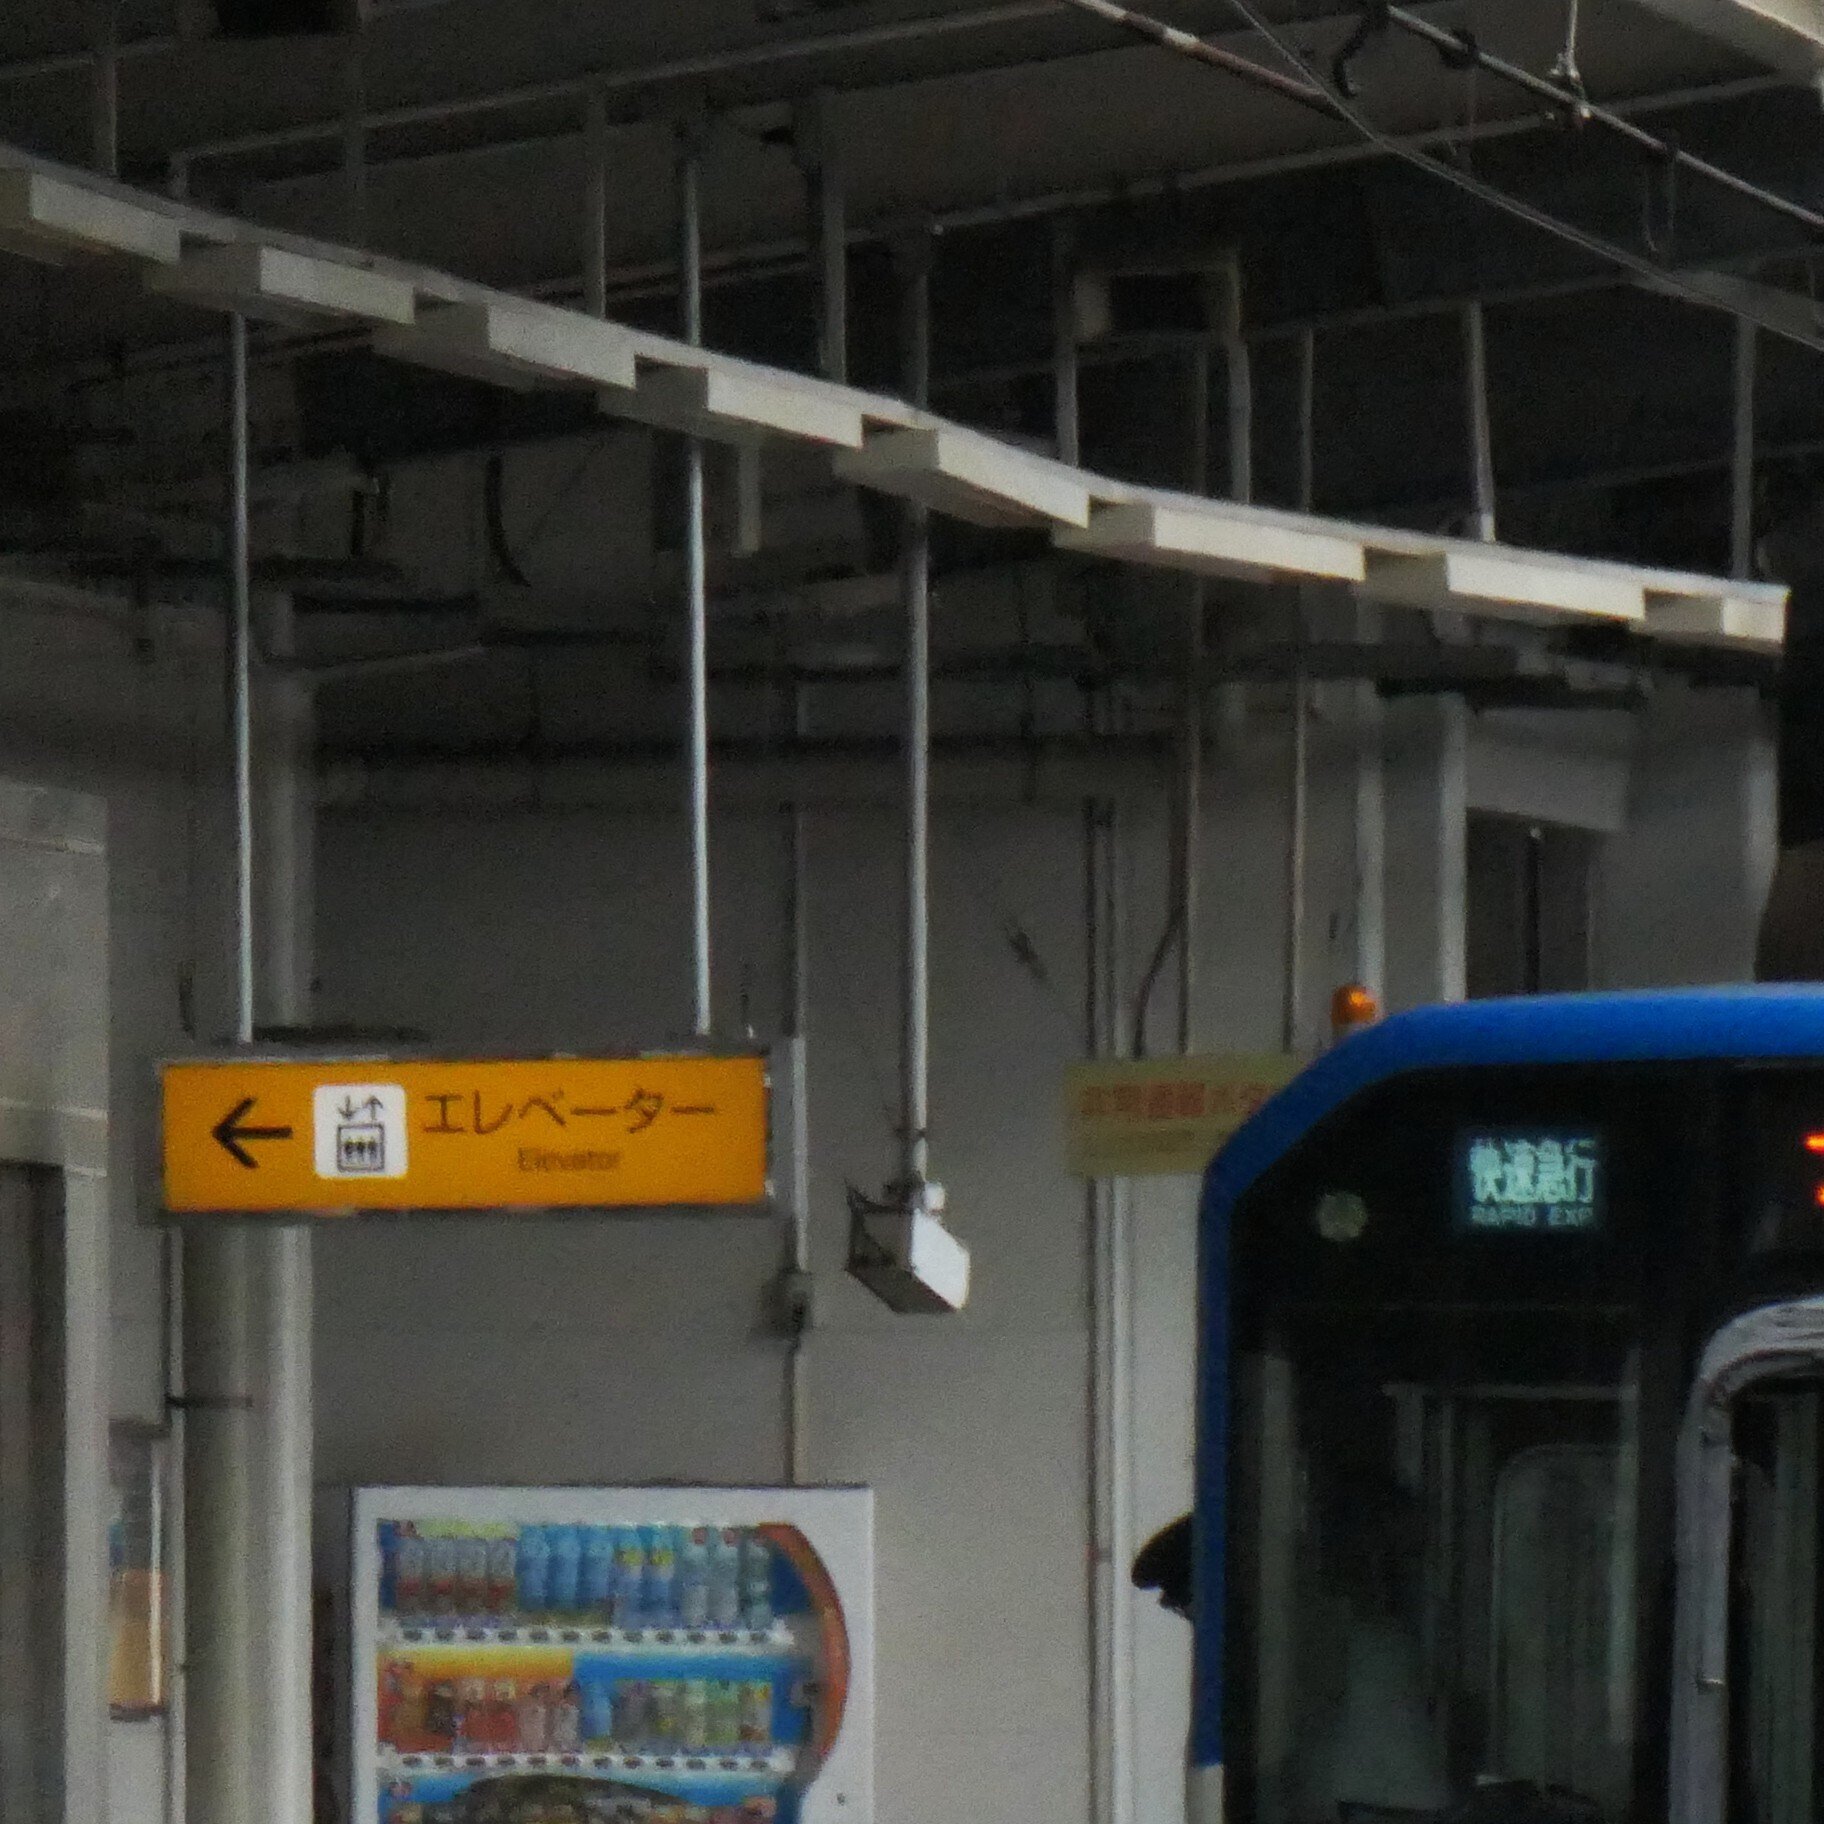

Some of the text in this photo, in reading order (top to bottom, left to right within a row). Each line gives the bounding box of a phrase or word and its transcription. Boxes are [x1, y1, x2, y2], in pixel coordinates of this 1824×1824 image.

[422, 1086, 716, 1135] エレベーター
[1469, 1138, 1598, 1204] 快速急行
